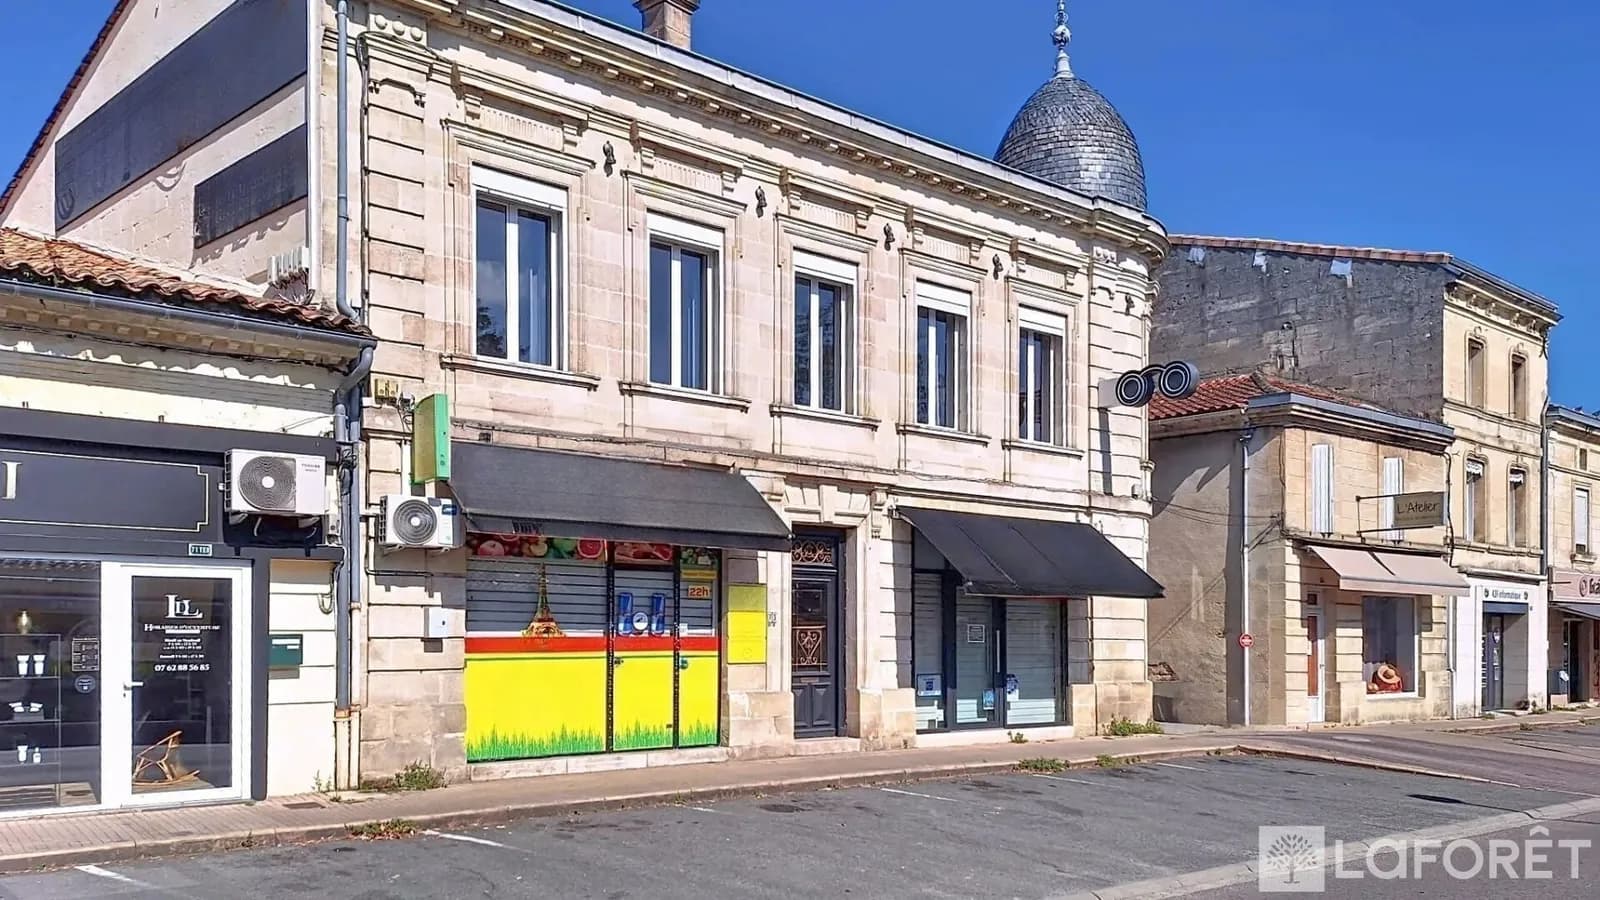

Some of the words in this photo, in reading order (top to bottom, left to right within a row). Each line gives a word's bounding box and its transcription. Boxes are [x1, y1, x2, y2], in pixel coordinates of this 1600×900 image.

[1397, 501, 1441, 514] L'Atelier
[689, 587, 709, 597] 22h
[154, 664, 166, 672] 07
